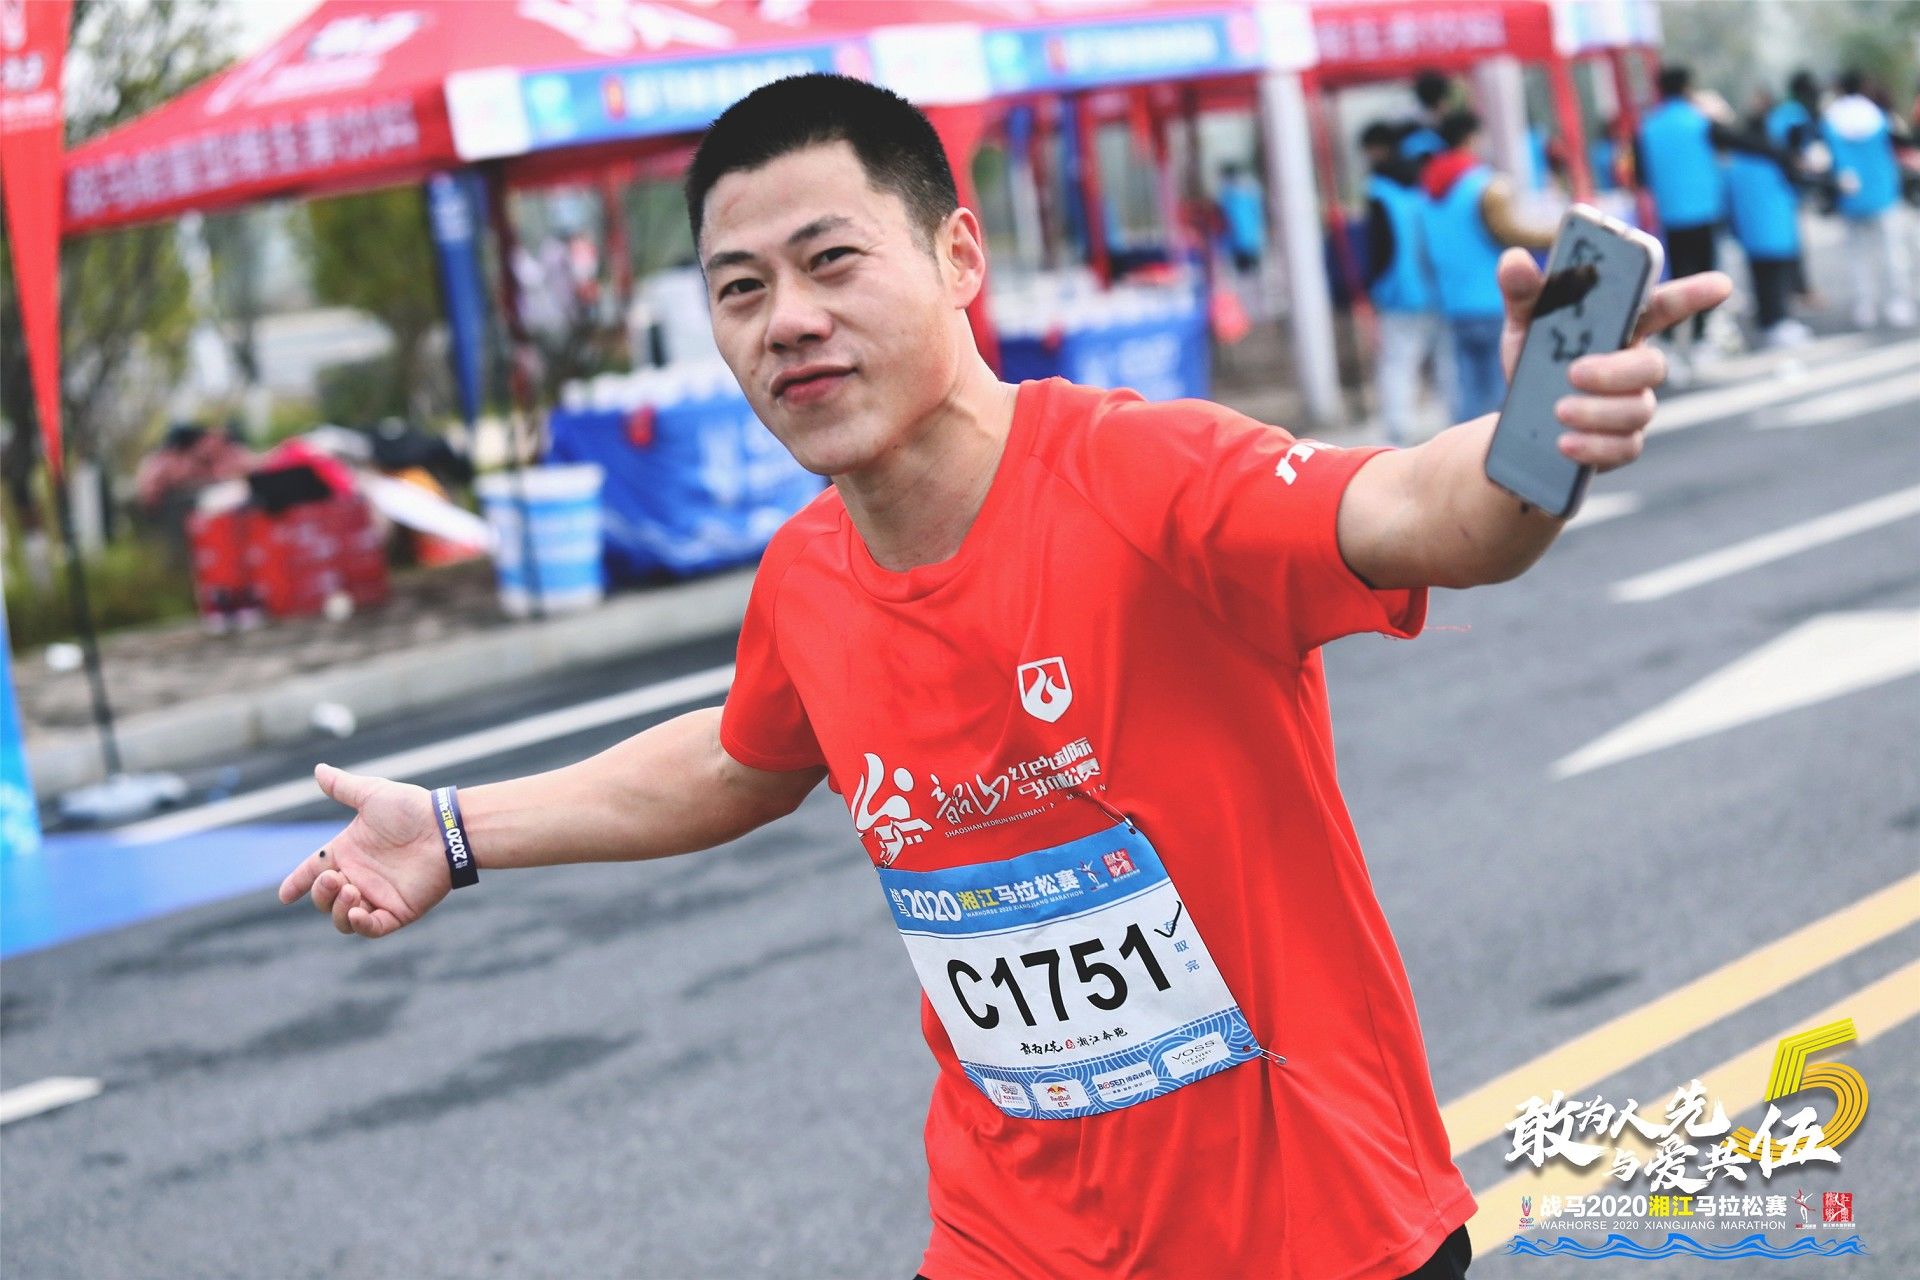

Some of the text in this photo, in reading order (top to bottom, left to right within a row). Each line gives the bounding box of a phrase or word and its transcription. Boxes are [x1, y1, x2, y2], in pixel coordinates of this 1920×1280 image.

[1008, 737, 1093, 781] 红色国际
[944, 823, 983, 839] SHAOSHAN
[983, 817, 1008, 829] REDRUN
[966, 890, 1084, 919] WARHORSE 2020 XIANGJIANG MARATHON
[947, 923, 1172, 1030] C1751
[1172, 1039, 1216, 1061] VOSS
